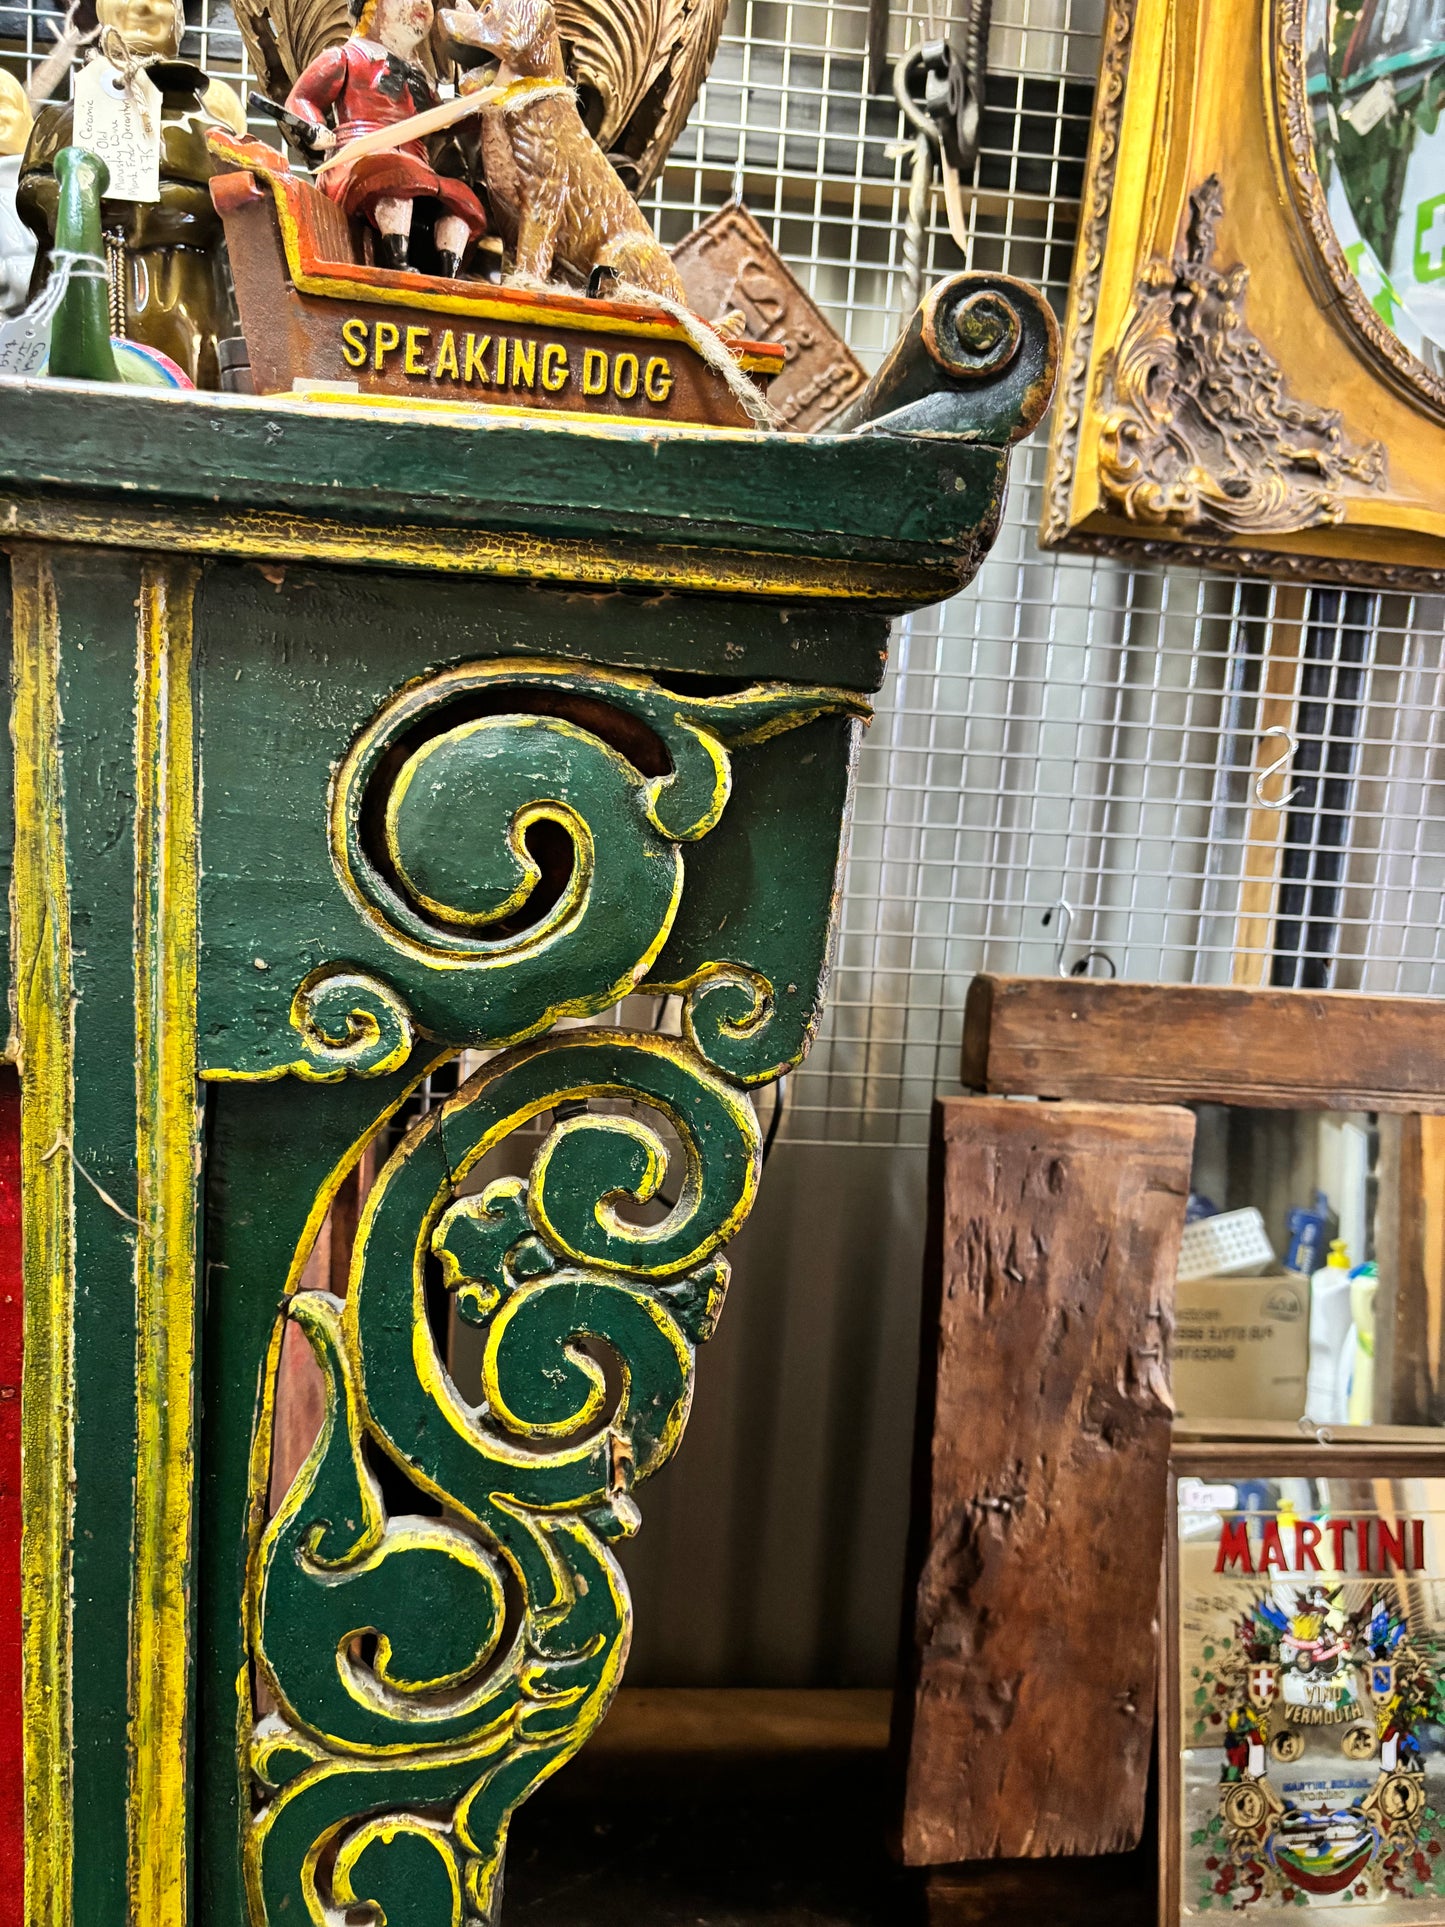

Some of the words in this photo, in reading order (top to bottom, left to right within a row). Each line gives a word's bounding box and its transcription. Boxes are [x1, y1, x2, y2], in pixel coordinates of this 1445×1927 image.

[342, 319, 569, 391] SPEAKING
[583, 348, 673, 402] DOG
[1214, 1519, 1425, 1574] MARTINI
[1284, 1701, 1364, 1726] VERMOUTH
